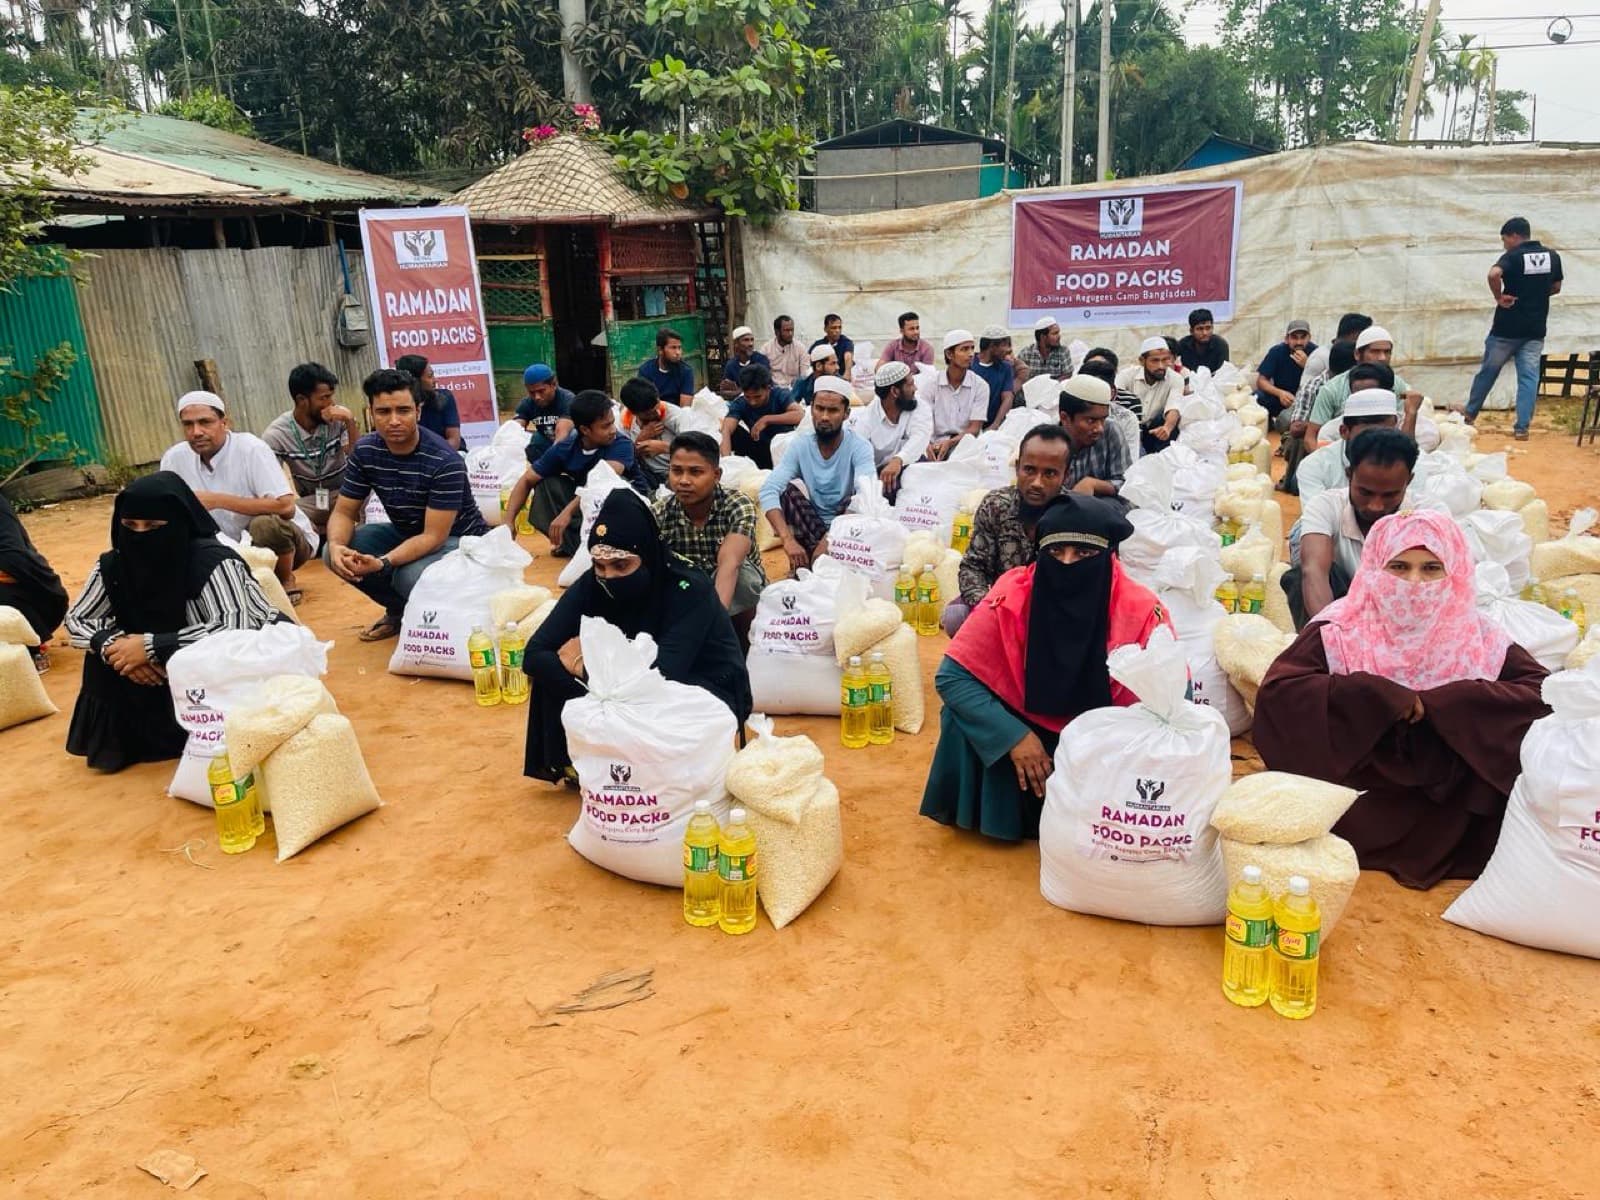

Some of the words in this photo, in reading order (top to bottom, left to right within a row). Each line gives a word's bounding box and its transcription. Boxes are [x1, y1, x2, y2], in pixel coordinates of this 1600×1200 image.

[1070, 240, 1170, 261] RAMADAN
[1055, 273, 1110, 291] FOOD
[1115, 269, 1184, 289] PACKS
[385, 287, 473, 318] RAMADAN
[1115, 291, 1140, 302] Camp
[1143, 288, 1196, 301] Bangladesh
[391, 329, 429, 348] FOOD
[432, 325, 476, 346] PACKS
[832, 540, 871, 553] RAMADAN
[846, 554, 875, 567] PACKS
[408, 630, 449, 641] RAMADAN
[784, 631, 819, 641] PACKS
[424, 645, 455, 656] PACKS
[587, 790, 658, 807] RAMADAN
[586, 804, 617, 823] FOOD
[621, 812, 670, 826] PACKS
[1102, 806, 1186, 829] RAMADAN
[1092, 824, 1135, 845] FOOD
[1140, 834, 1193, 848] PACKS
